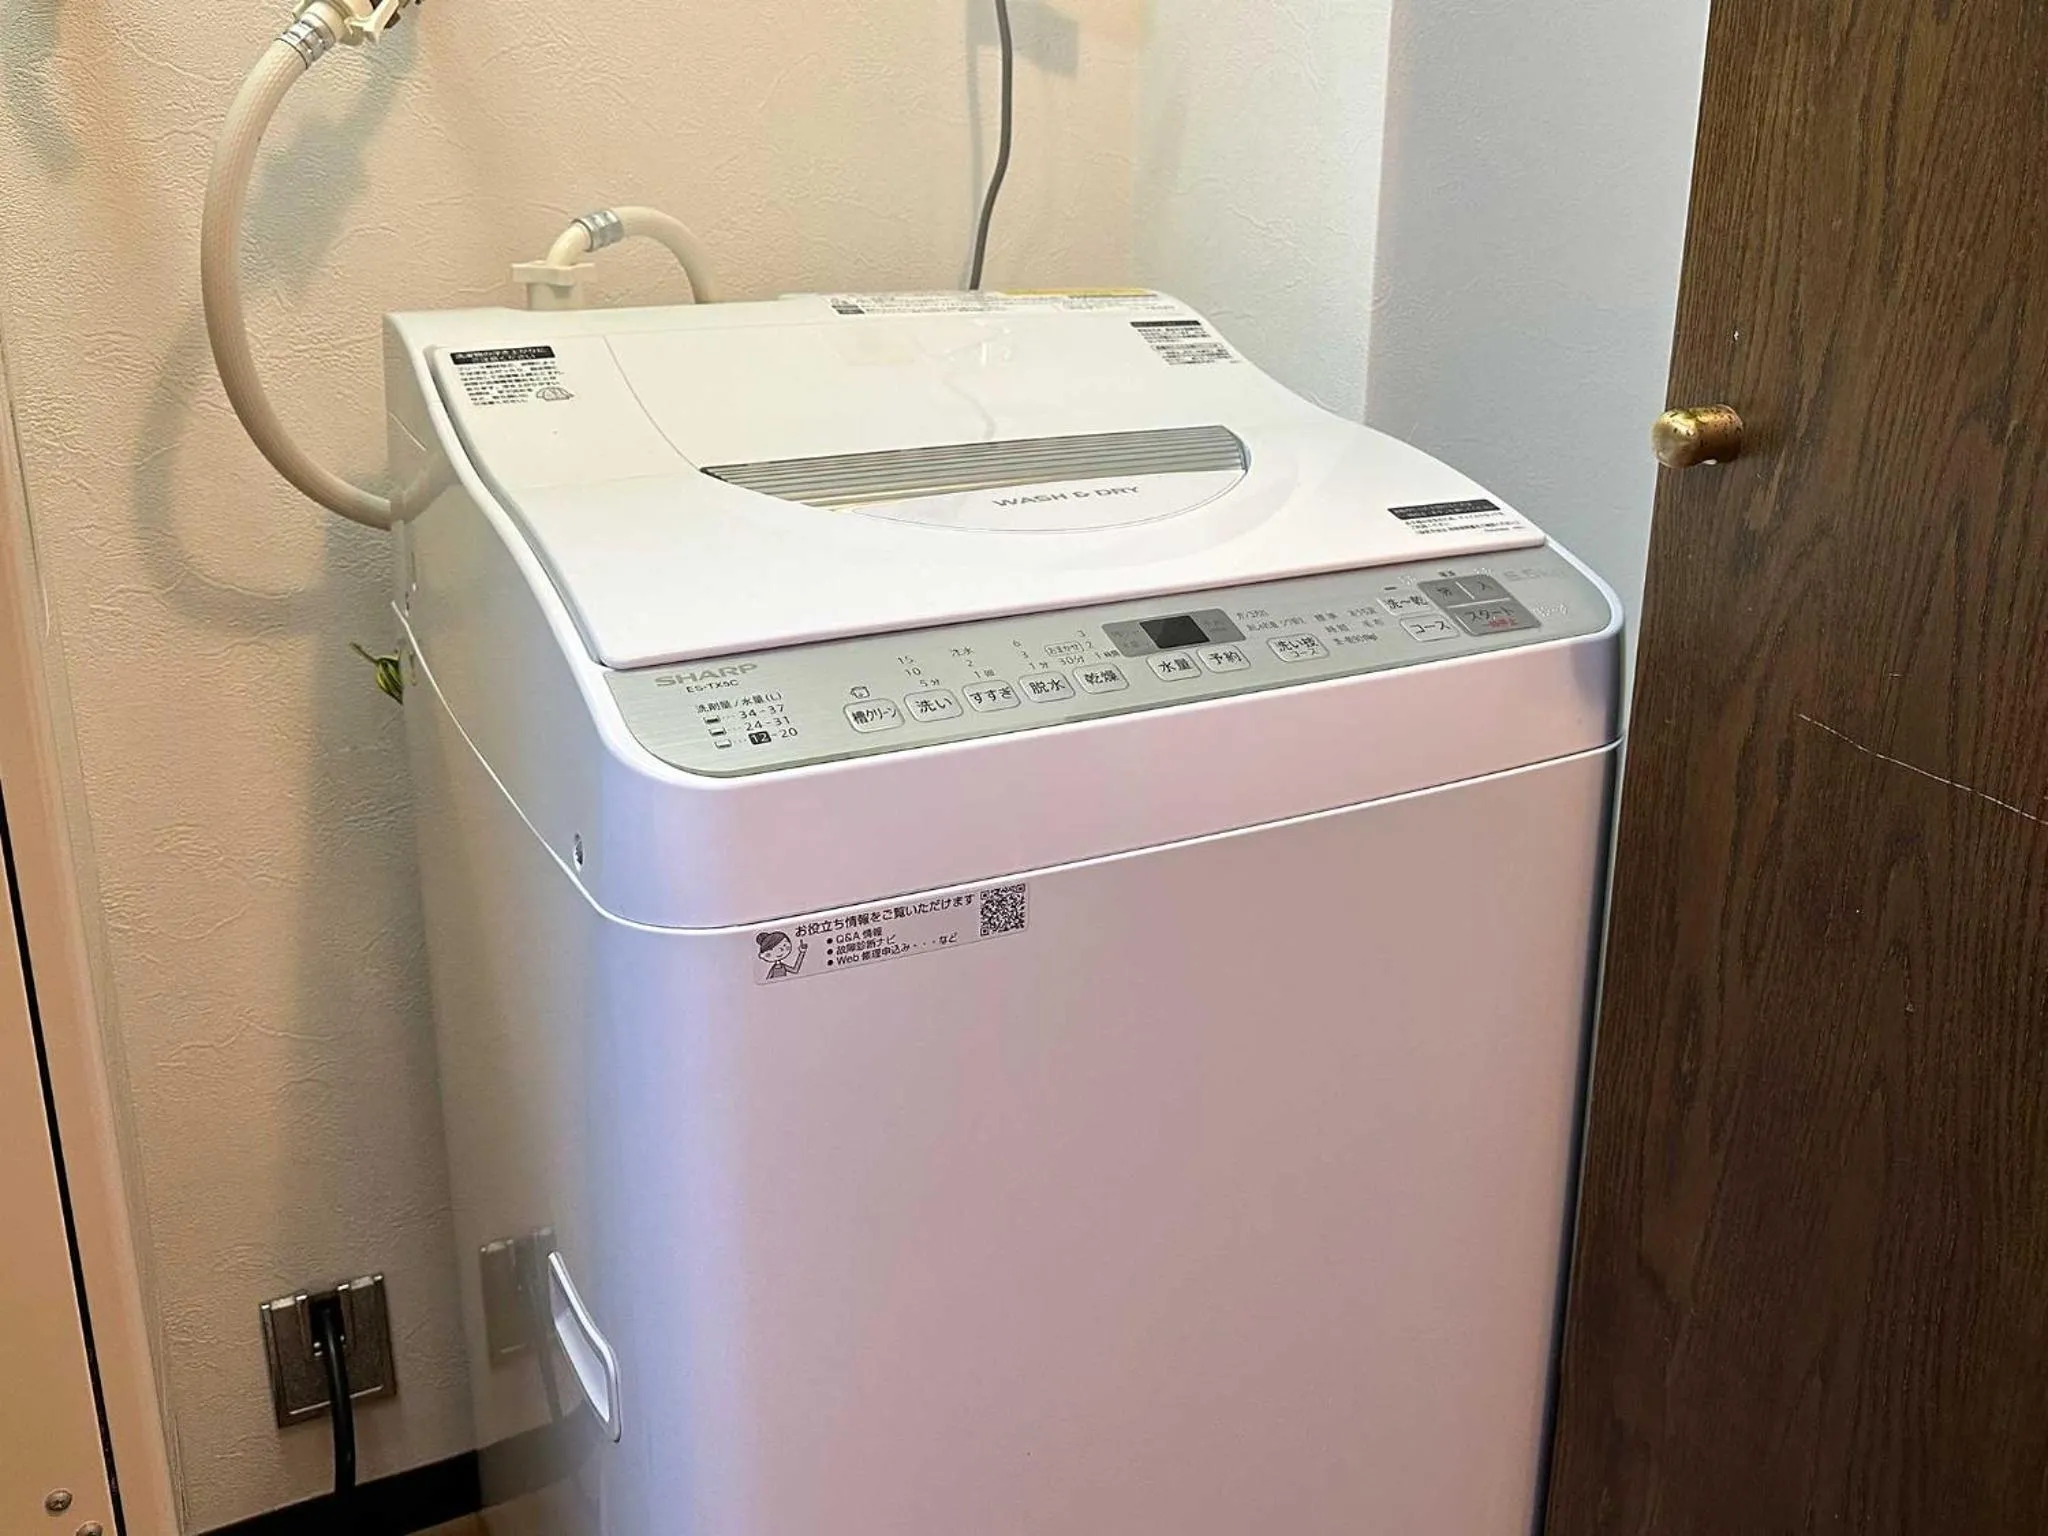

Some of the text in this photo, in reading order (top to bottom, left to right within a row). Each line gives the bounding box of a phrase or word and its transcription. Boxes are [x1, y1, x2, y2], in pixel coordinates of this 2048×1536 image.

[992, 486, 1139, 507] WASH & DRY
[1464, 606, 1515, 622] スタート
[1410, 620, 1452, 634] コース
[898, 655, 914, 665] 15
[966, 659, 974, 668] 2
[1158, 656, 1194, 673] 水量
[1209, 651, 1243, 666] 予約
[654, 662, 758, 687] SHARP
[905, 667, 921, 677] 10
[1084, 668, 1120, 685] 乾燥
[1029, 679, 1066, 695] 脱水
[969, 687, 1013, 704] すすぎ
[916, 697, 952, 714] 洗い
[851, 706, 898, 725] 槽クリーン
[795, 894, 975, 938] お役立ち情報をご覧いただけます
[836, 931, 861, 944] Q&A
[836, 953, 860, 966] Web
